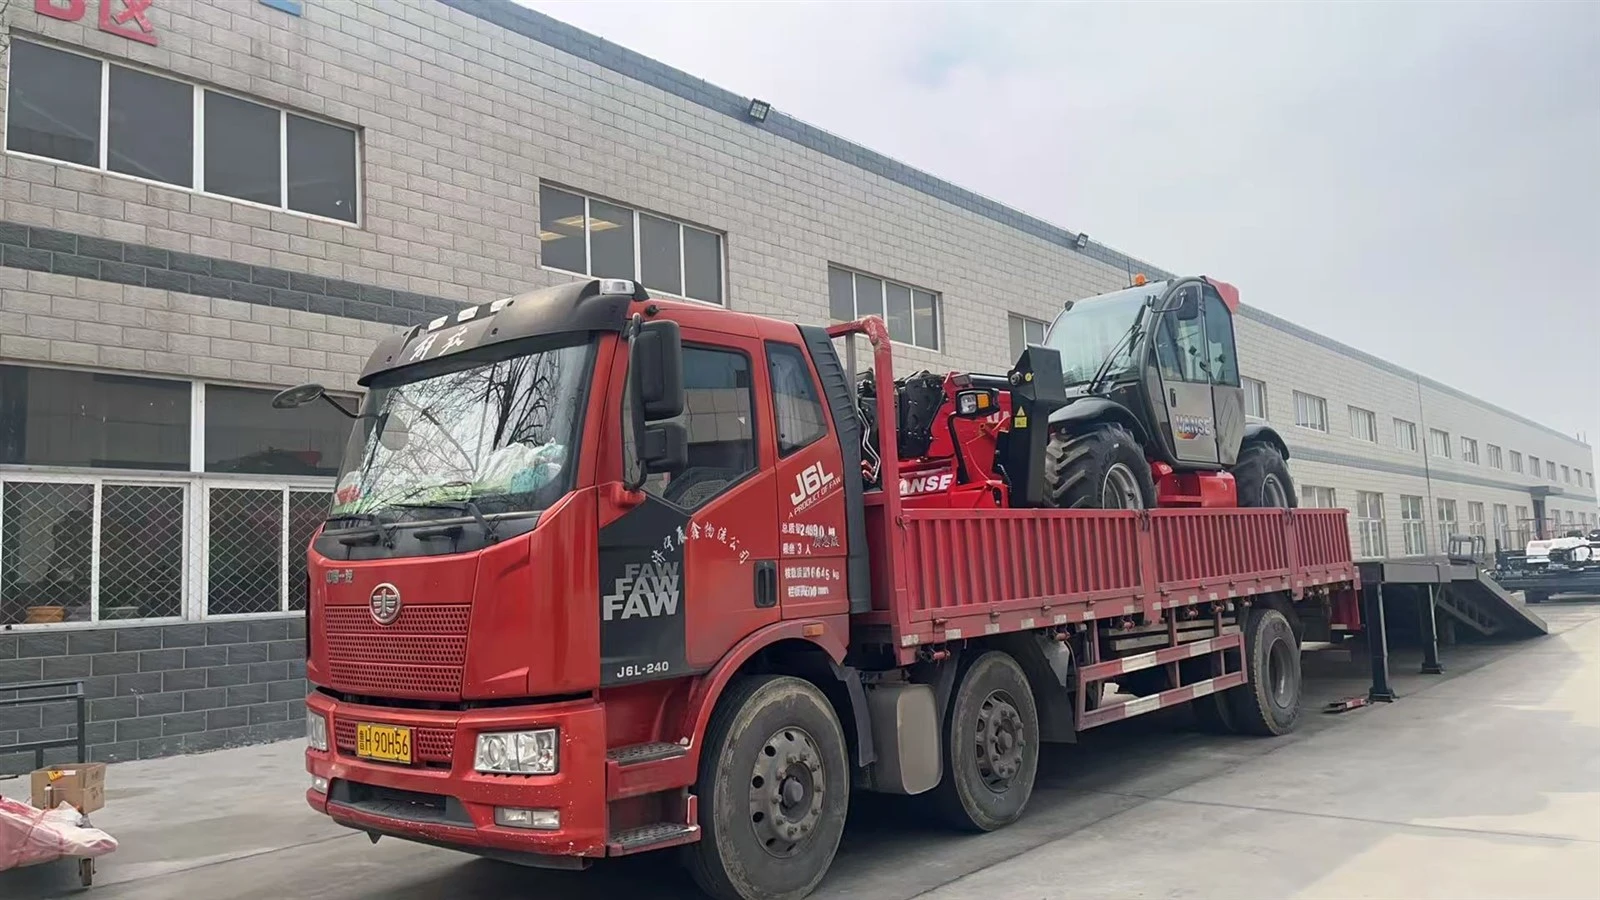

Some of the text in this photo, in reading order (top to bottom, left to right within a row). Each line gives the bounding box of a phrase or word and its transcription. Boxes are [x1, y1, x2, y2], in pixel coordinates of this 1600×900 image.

[790, 461, 834, 506] J6L
[899, 474, 953, 495] ANSE
[794, 493, 821, 515] PRODUCT
[820, 485, 830, 495] OF
[829, 476, 841, 489] FAW
[625, 561, 679, 580] FAW
[615, 575, 679, 597] FAW
[603, 591, 679, 621] FAW
[617, 661, 669, 678] J6L-240
